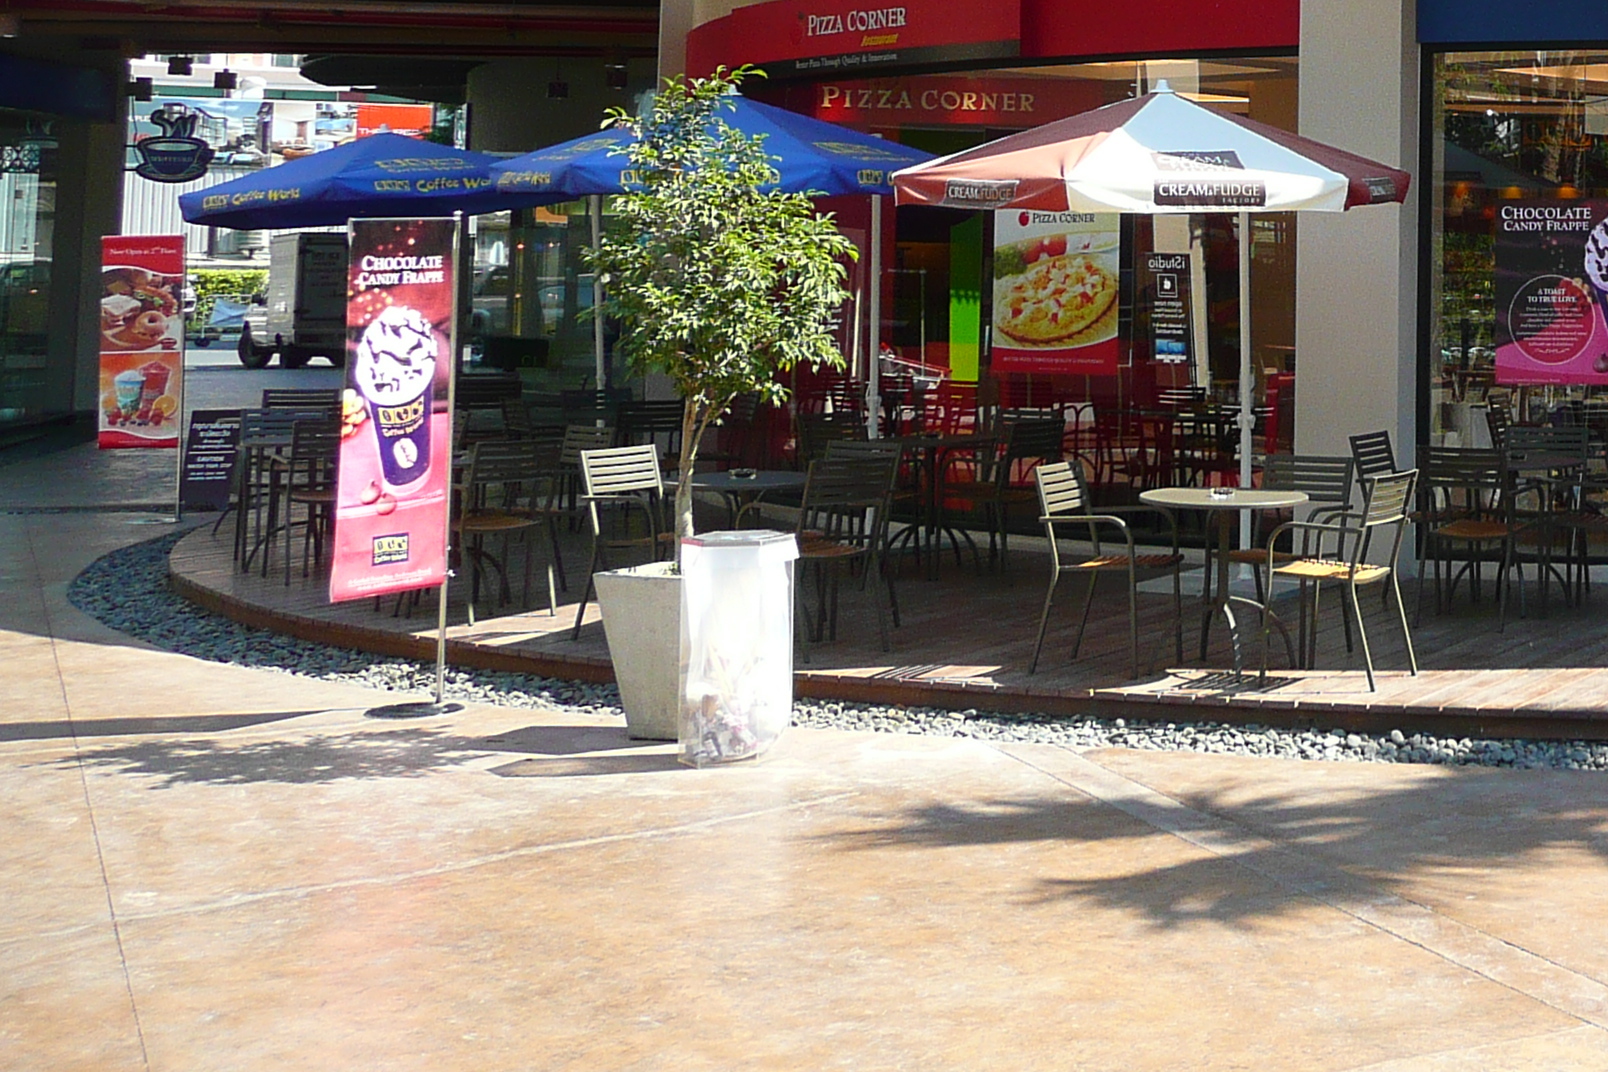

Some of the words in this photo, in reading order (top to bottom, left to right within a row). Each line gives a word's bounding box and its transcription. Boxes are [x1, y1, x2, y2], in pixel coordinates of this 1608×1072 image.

[807, 14, 844, 36] PIZZA
[847, 8, 907, 31] CORNER
[821, 86, 912, 109] PIZZA
[921, 90, 1035, 112] CORNER
[416, 178, 458, 192] Coffee
[232, 191, 265, 205] Coffee
[267, 188, 300, 202] World
[1032, 213, 1057, 224] PIZZA
[1059, 213, 1096, 224] CORNER
[1501, 205, 1592, 220] CHOCOLATE
[1503, 220, 1543, 231] CANDY
[1546, 219, 1590, 231] FRAPPE
[361, 255, 443, 271] CHOCOLATE
[358, 272, 400, 286] CANDY
